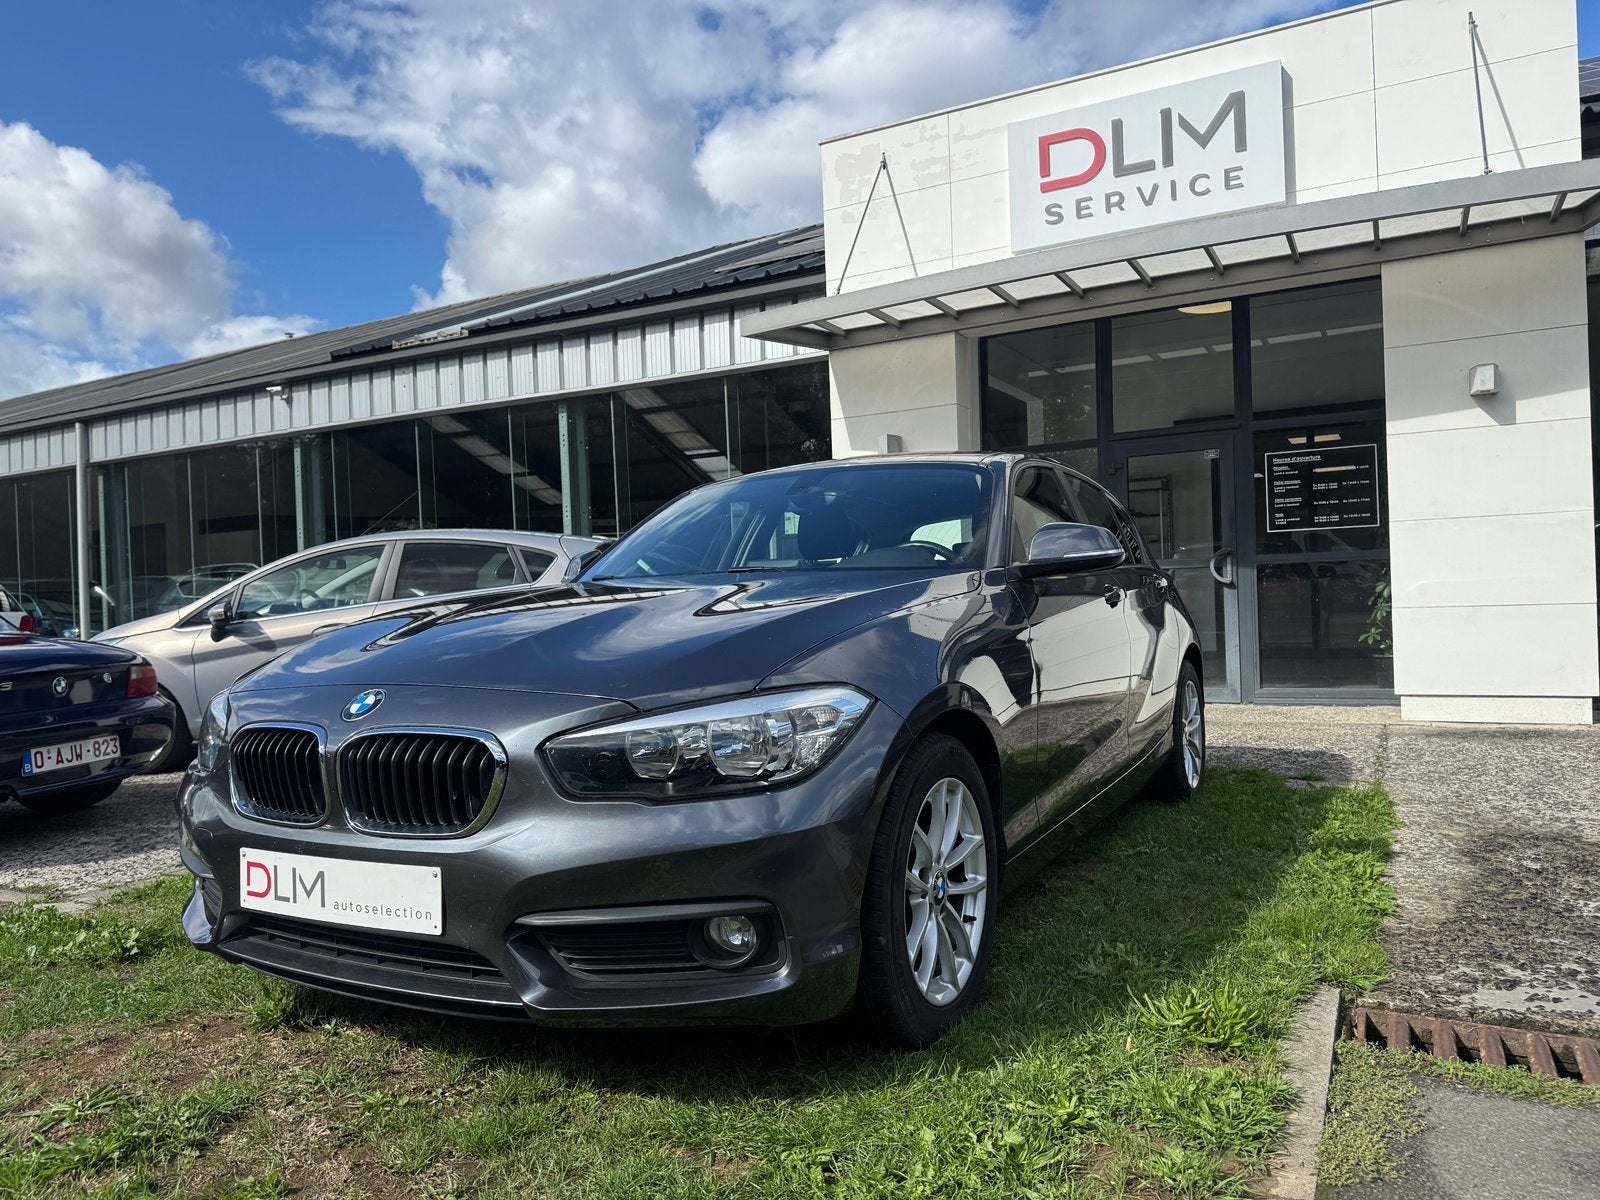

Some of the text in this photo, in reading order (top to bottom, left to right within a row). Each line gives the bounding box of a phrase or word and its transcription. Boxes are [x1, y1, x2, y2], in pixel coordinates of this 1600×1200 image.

[1038, 90, 1247, 193] DLM
[1044, 165, 1245, 225] SERVICE
[24, 764, 32, 773] B
[246, 860, 326, 908] DLM
[333, 899, 432, 921] autoselection
